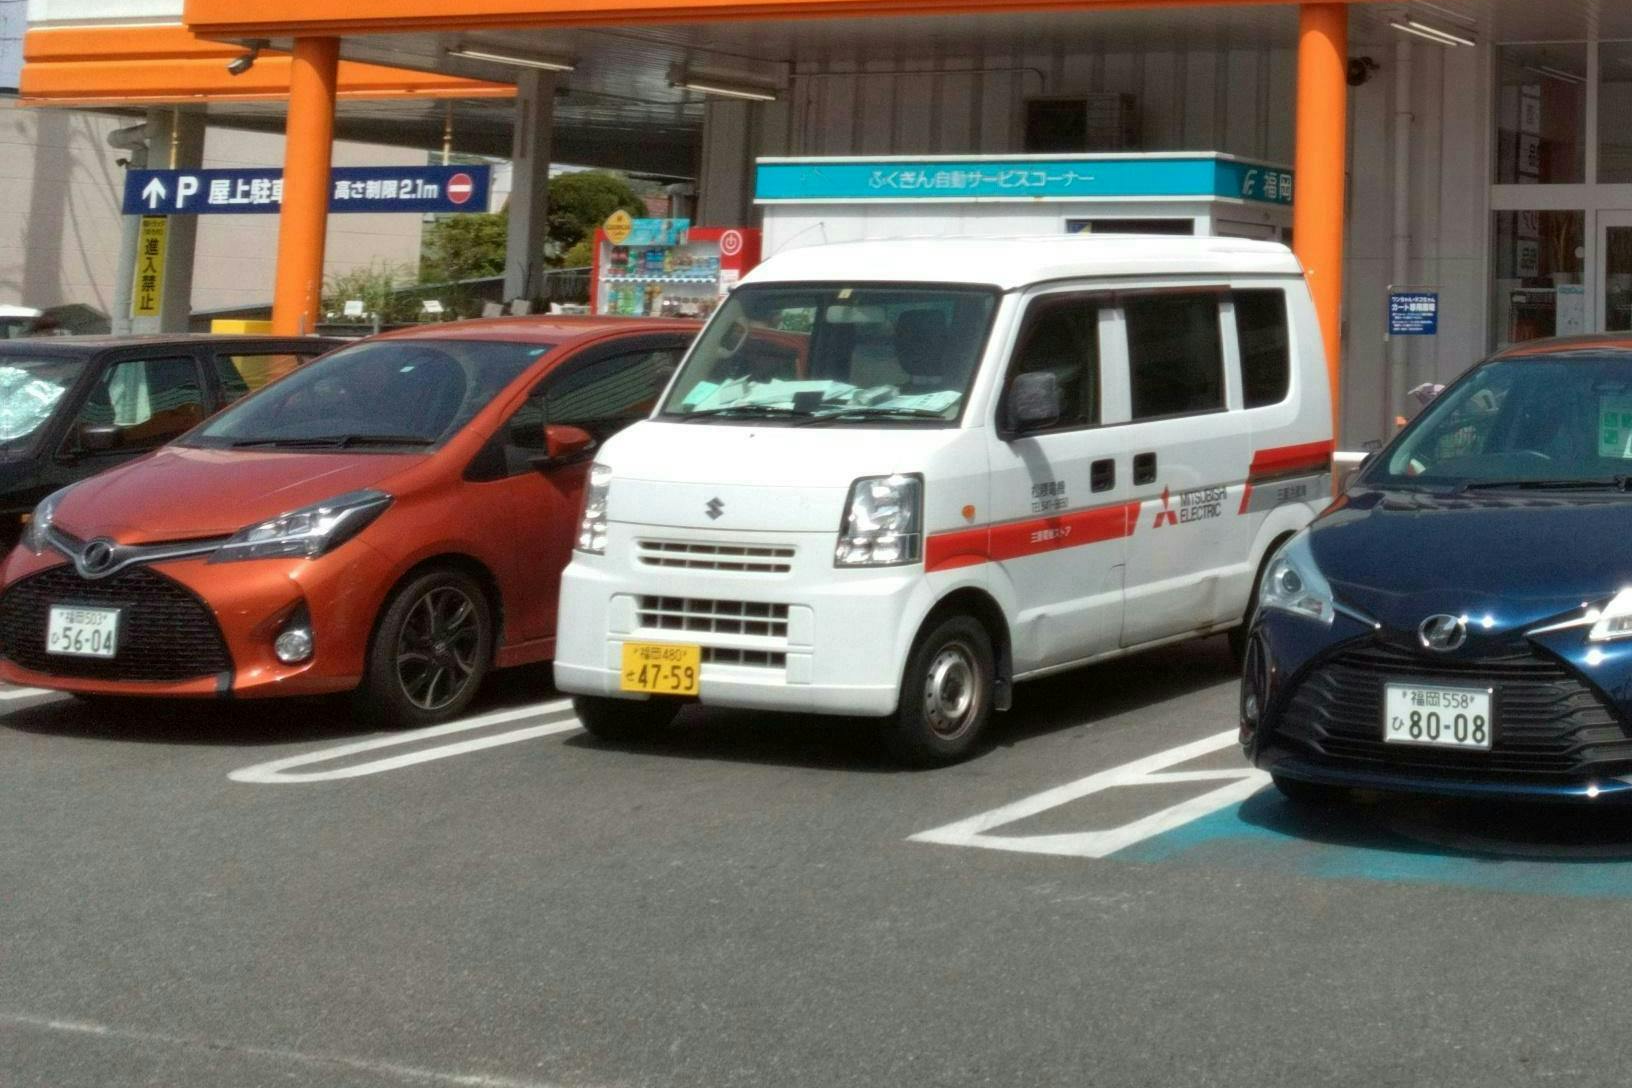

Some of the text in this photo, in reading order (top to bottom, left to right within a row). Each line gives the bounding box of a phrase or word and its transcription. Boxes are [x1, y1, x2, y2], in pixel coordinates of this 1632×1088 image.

[176, 176, 199, 209] P
[868, 169, 1096, 190] ふくぎん自動サービスコーナー
[139, 237, 160, 311] 進入禁止
[1179, 484, 1229, 507] MITSUBISHI
[1179, 502, 1222, 524] ELECTRIC
[61, 626, 114, 654] 56-04
[638, 663, 695, 691] 47-59
[1408, 710, 1487, 744] 80-08
